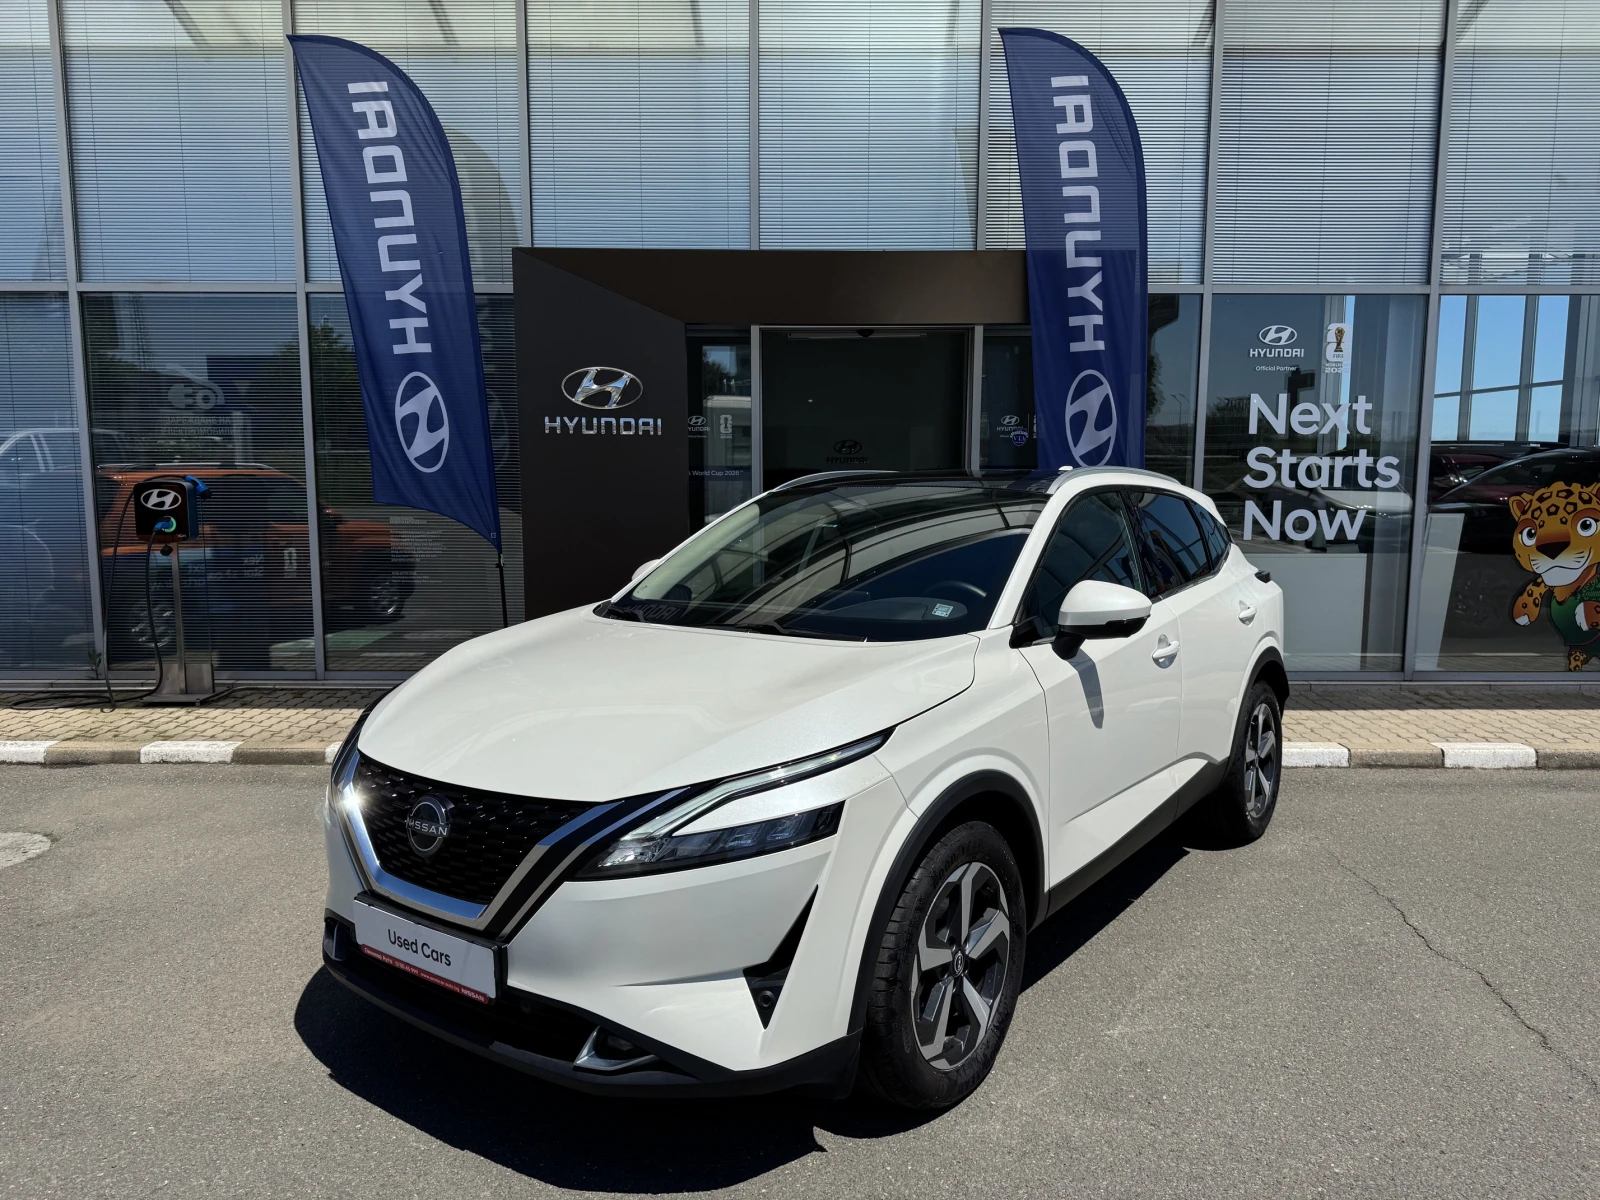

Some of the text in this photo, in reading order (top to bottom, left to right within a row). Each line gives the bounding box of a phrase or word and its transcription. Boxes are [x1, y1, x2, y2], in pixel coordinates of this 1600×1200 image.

[1249, 348, 1305, 358] HYUNDAI
[544, 416, 663, 436] HYUNDAI
[1248, 393, 1373, 436] Next
[1242, 446, 1400, 489] Starts
[1243, 500, 1368, 541] Now
[408, 818, 448, 836] NISSAN
[388, 927, 452, 968] Used Cars
[461, 988, 485, 1002] NISSAN
